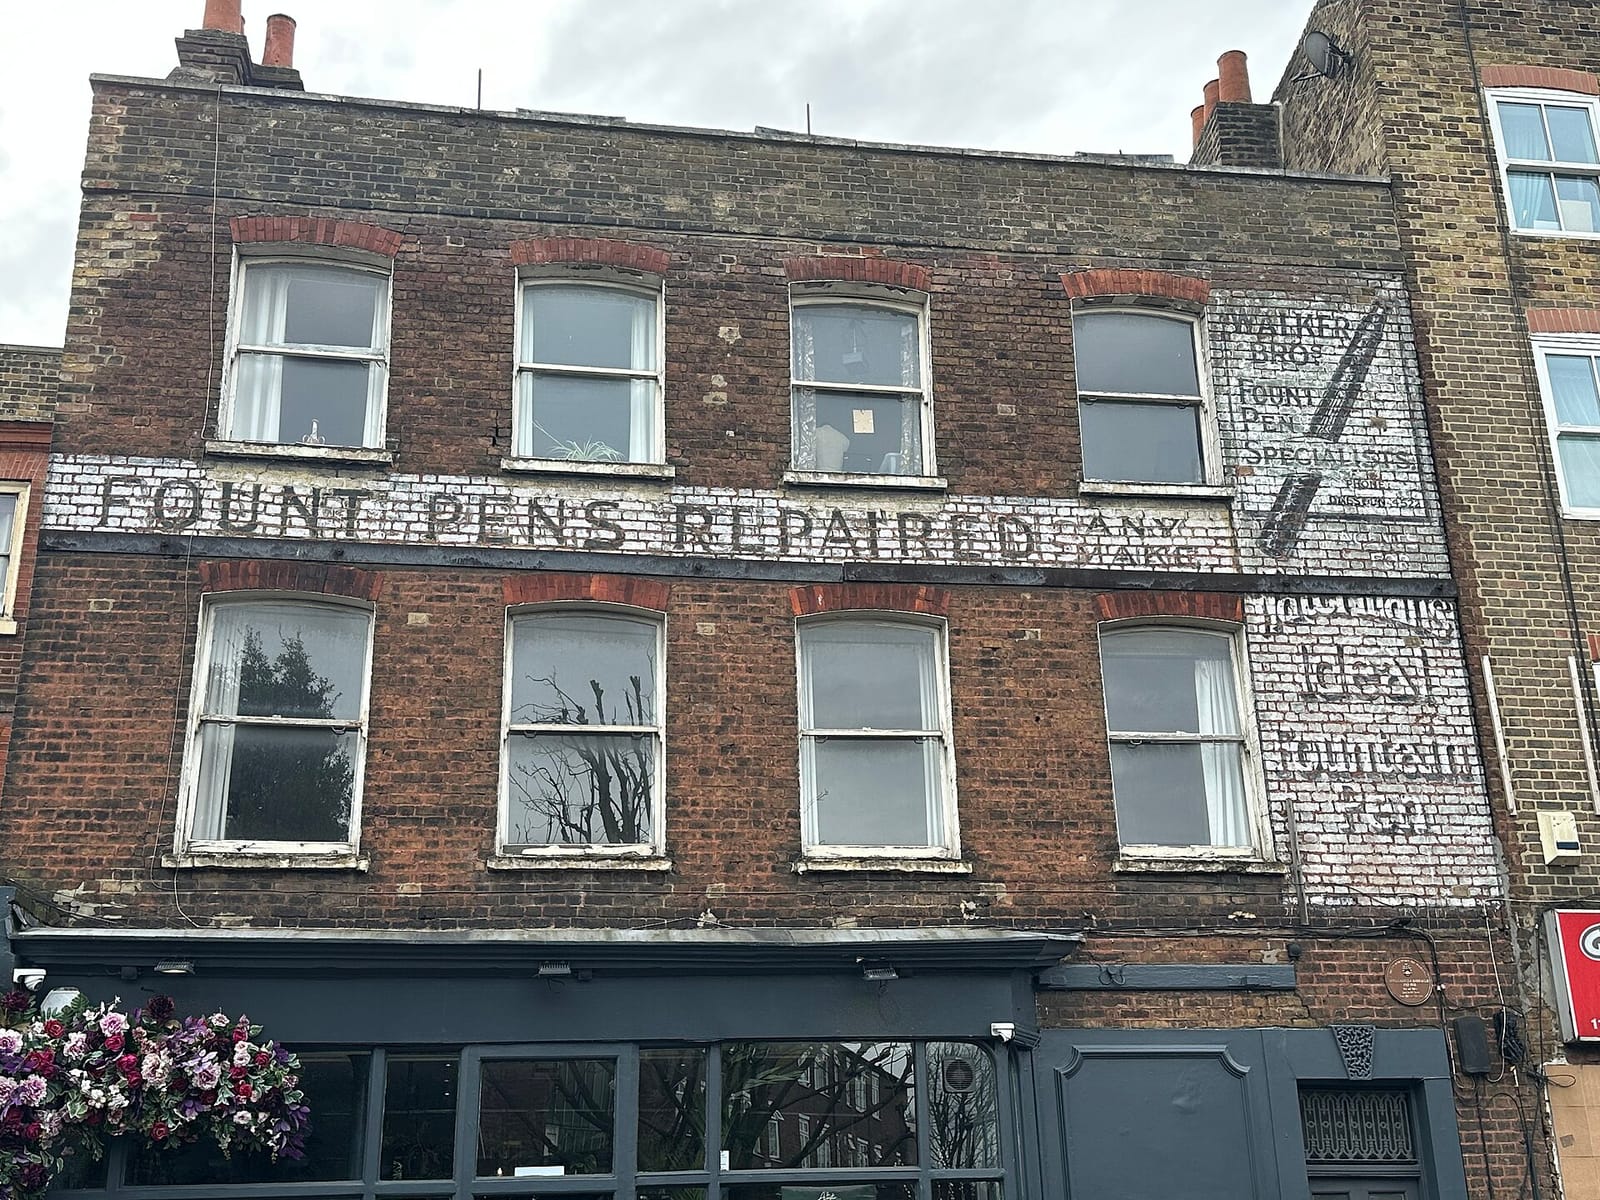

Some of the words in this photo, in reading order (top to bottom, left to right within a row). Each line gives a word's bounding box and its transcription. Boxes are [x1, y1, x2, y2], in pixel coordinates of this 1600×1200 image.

[1224, 312, 1351, 340] WALKER
[1239, 379, 1314, 408] FOUNT
[1242, 407, 1294, 433] PEN
[99, 475, 372, 537] FOUNT
[427, 493, 626, 550] PENS
[673, 504, 1035, 559] REPAIRED
[1087, 516, 1185, 537] ANY
